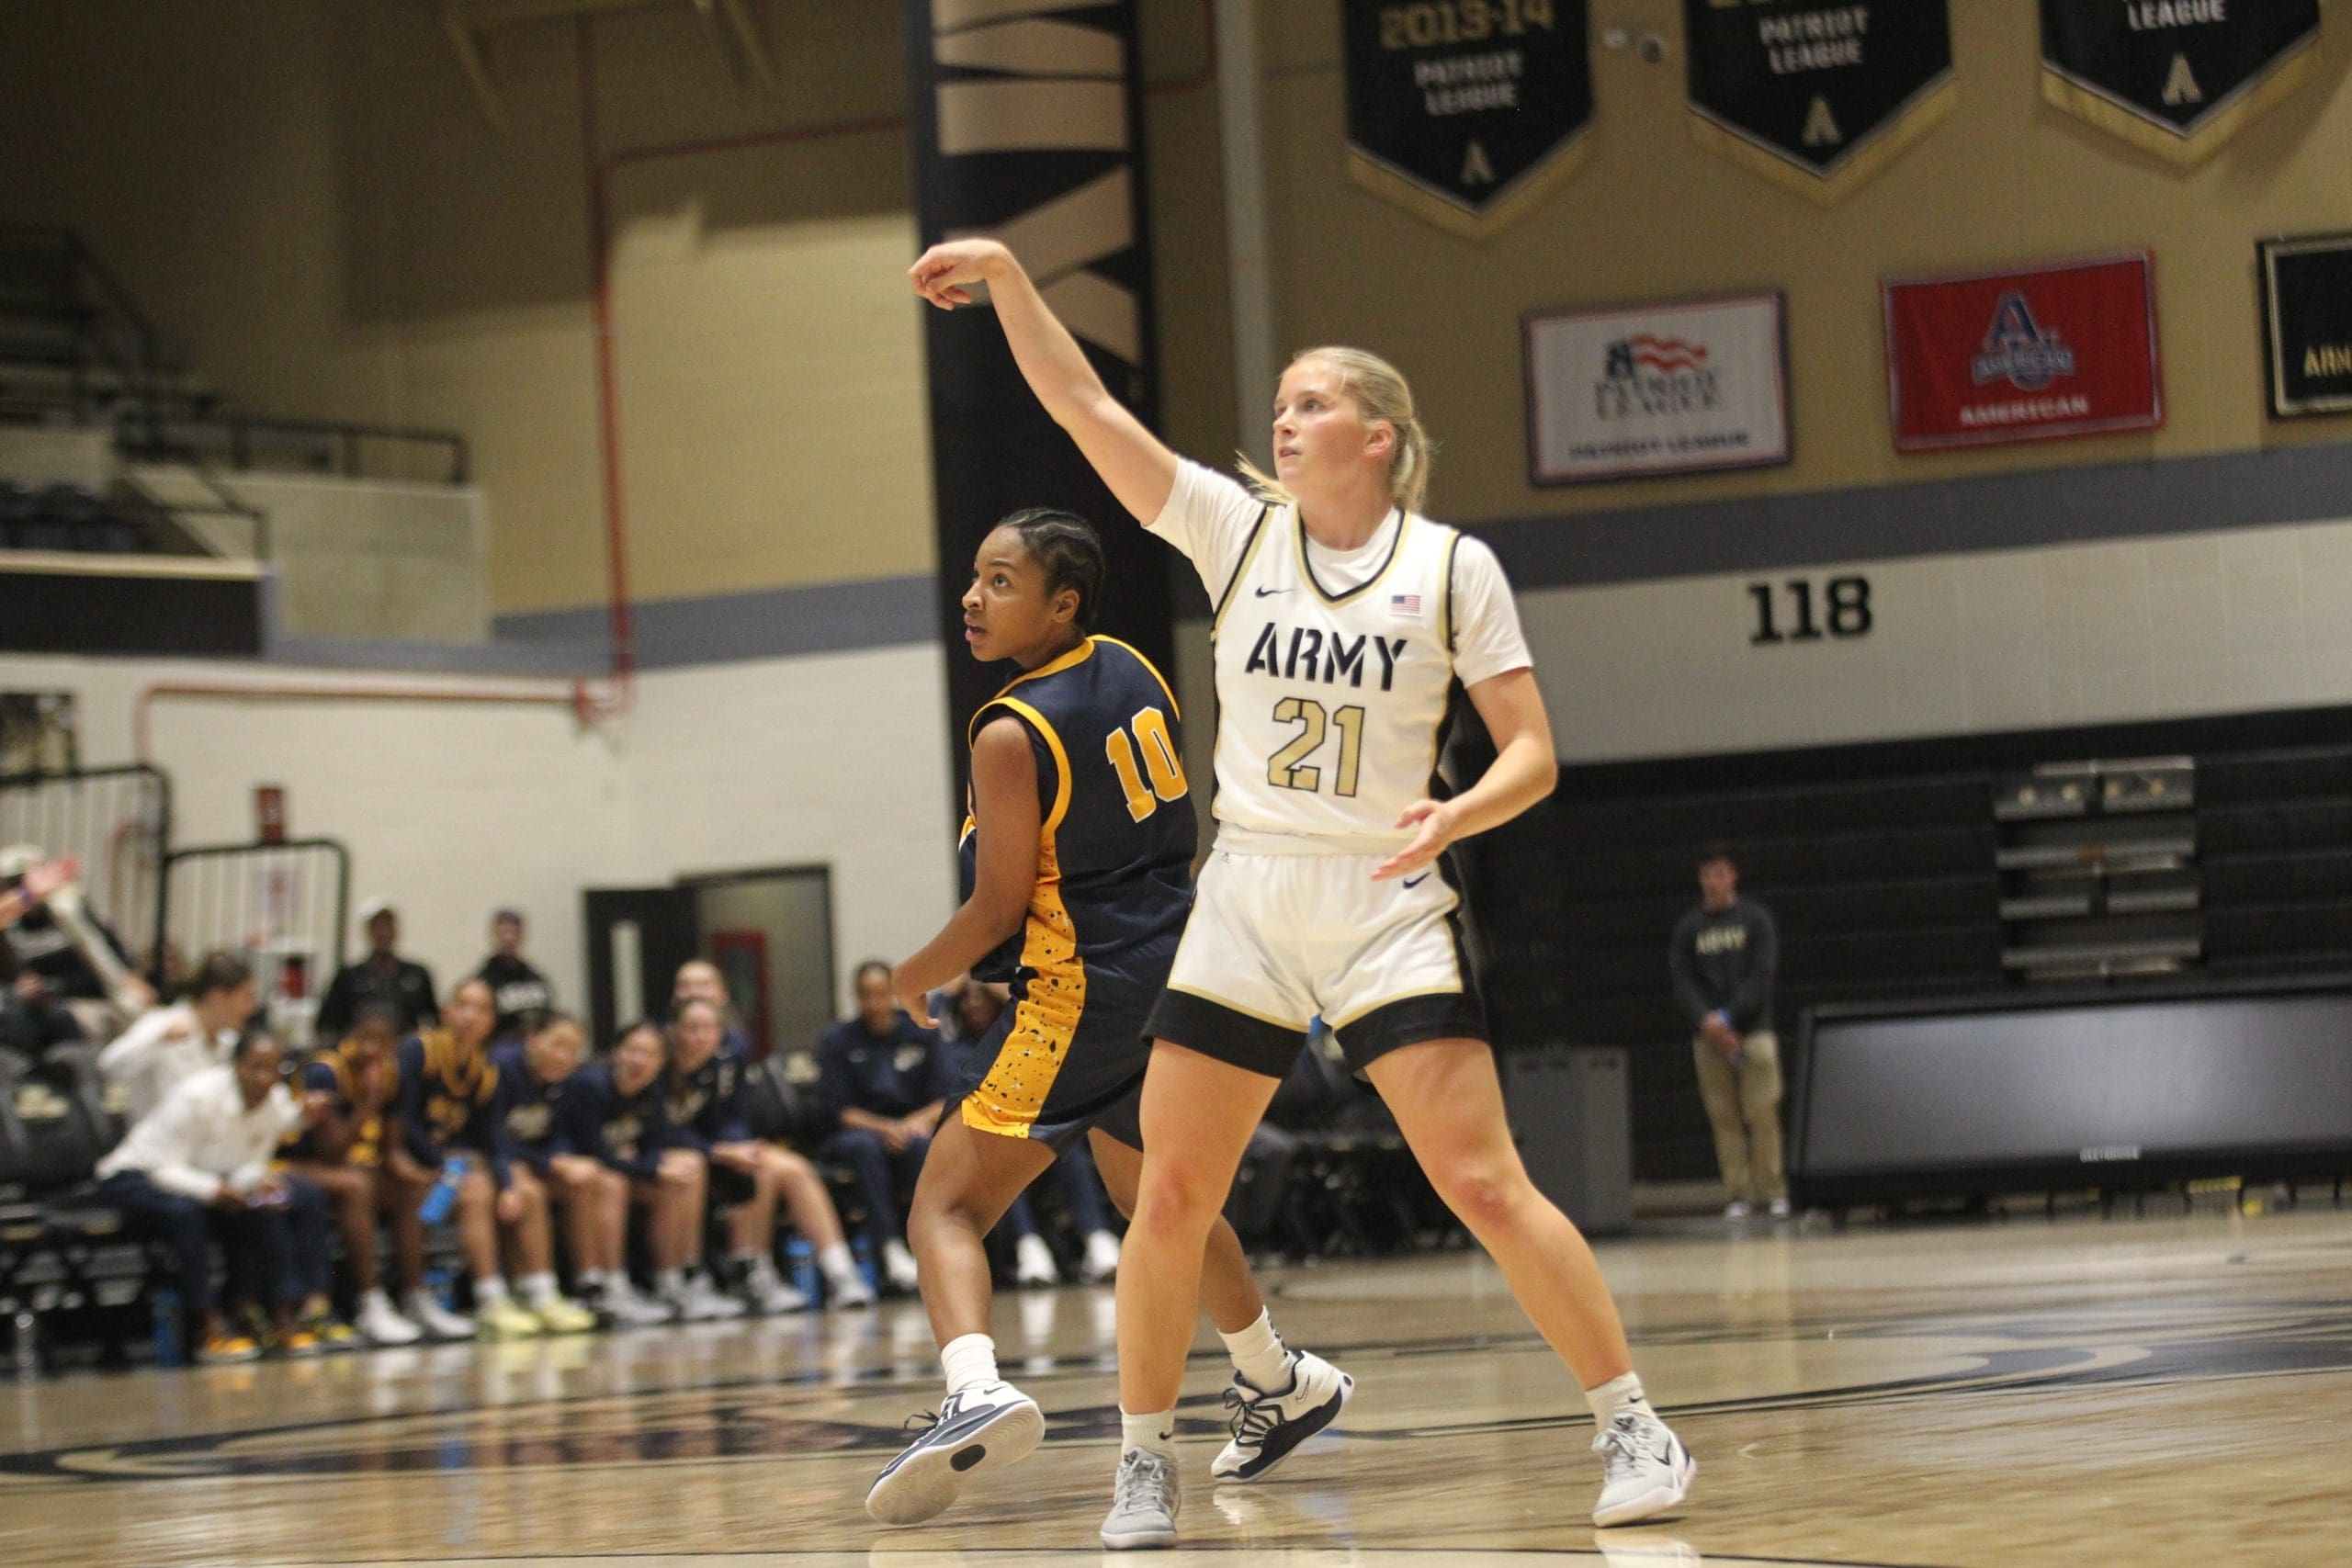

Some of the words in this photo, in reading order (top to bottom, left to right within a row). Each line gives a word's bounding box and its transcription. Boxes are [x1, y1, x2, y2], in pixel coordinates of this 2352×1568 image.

[1758, 6, 1869, 45] PATRIOT
[2127, 0, 2226, 31] LEAGUE
[1769, 37, 1863, 74] LEAGUE
[1425, 82, 1518, 116] LEAGUE
[1960, 395, 2090, 428] AMERICAN
[1747, 576, 1873, 645] 118
[1245, 621, 1408, 693] ARMY
[1105, 705, 1188, 824] 10
[1267, 696, 1366, 798] 21
